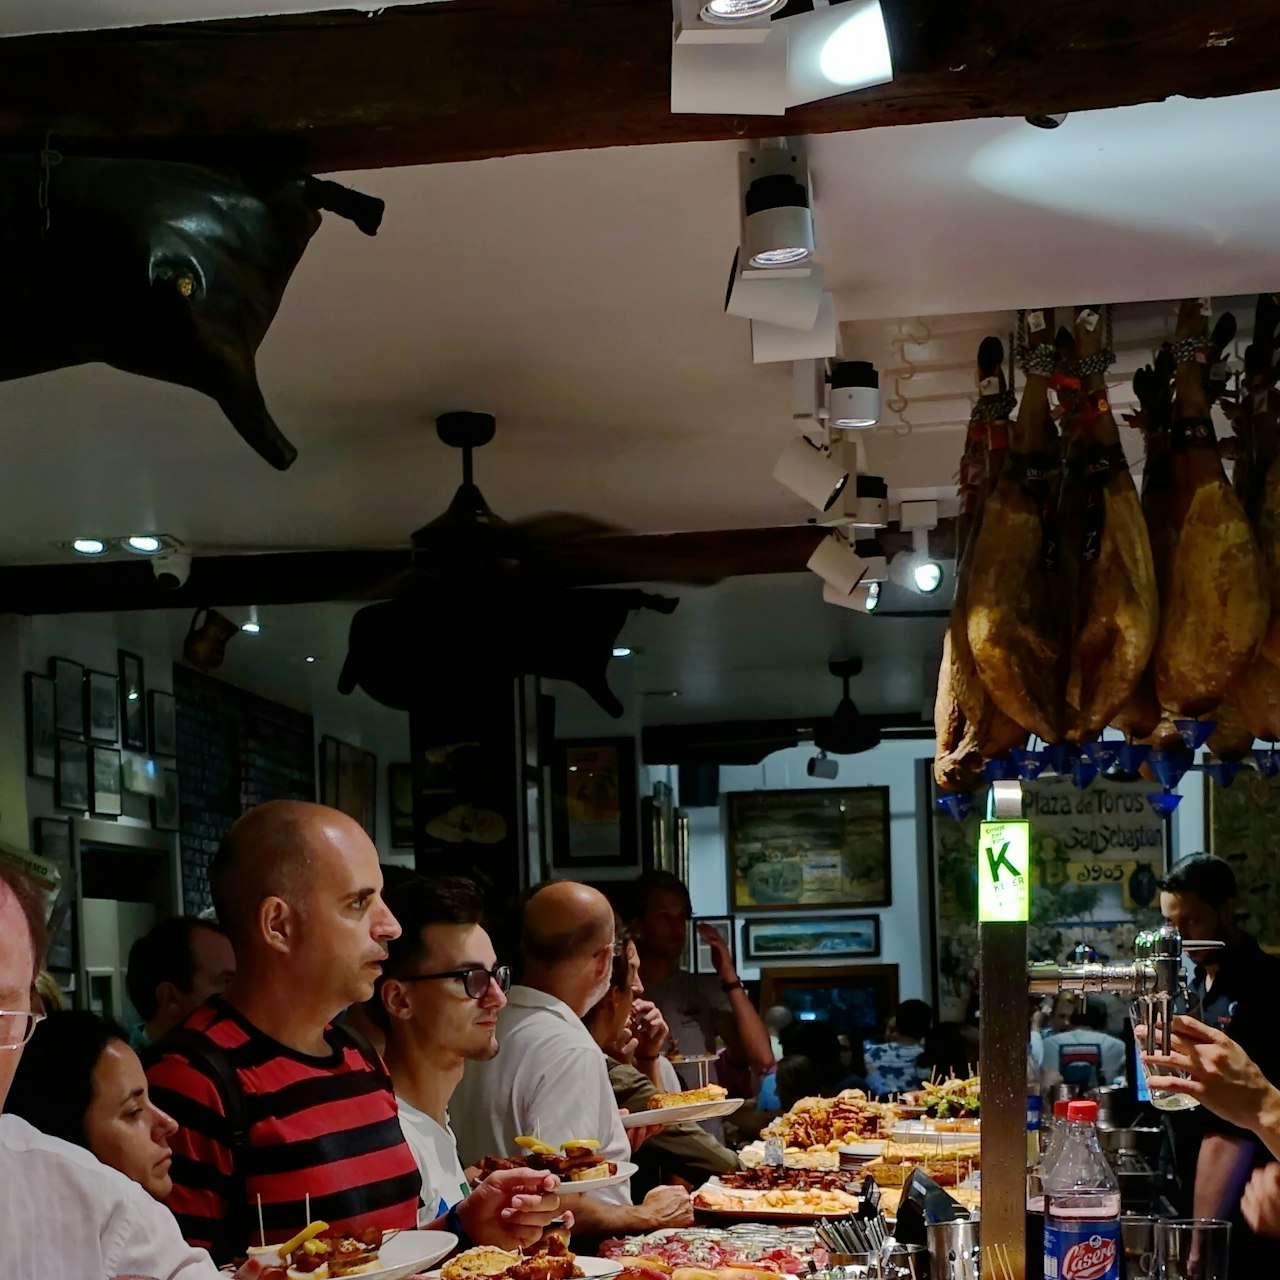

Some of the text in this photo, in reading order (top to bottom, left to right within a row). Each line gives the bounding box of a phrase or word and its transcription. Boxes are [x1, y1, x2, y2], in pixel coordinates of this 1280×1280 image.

[1022, 790, 1070, 815] Plaza
[1092, 789, 1144, 815] Toros
[986, 842, 1021, 883] K
[994, 877, 1024, 892] KEER
[1062, 1238, 1116, 1280] Casera
